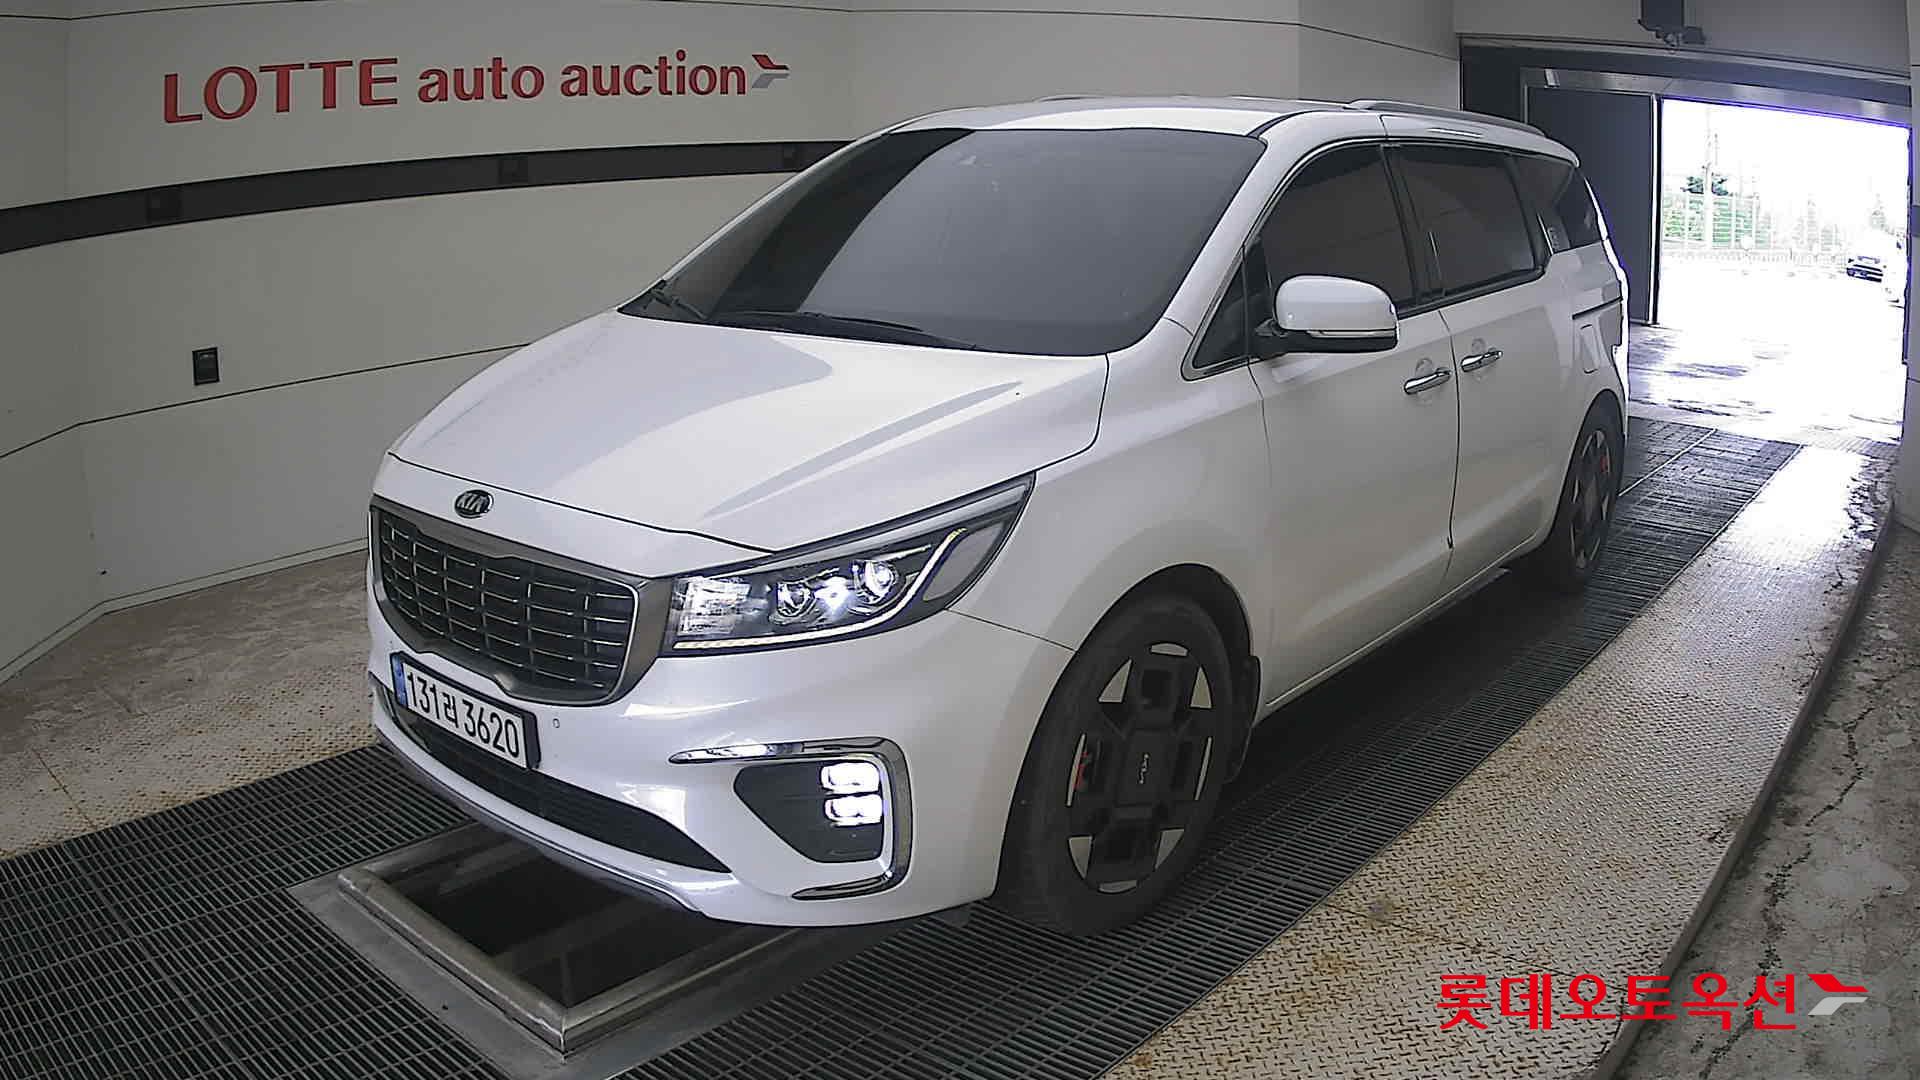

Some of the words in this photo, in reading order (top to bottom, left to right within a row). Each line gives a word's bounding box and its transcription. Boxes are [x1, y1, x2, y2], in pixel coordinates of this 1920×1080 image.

[163, 57, 398, 124] LOTTE
[417, 56, 545, 103] auto
[559, 49, 747, 98] auction
[456, 491, 491, 516] KIA
[462, 698, 519, 758] 3620
